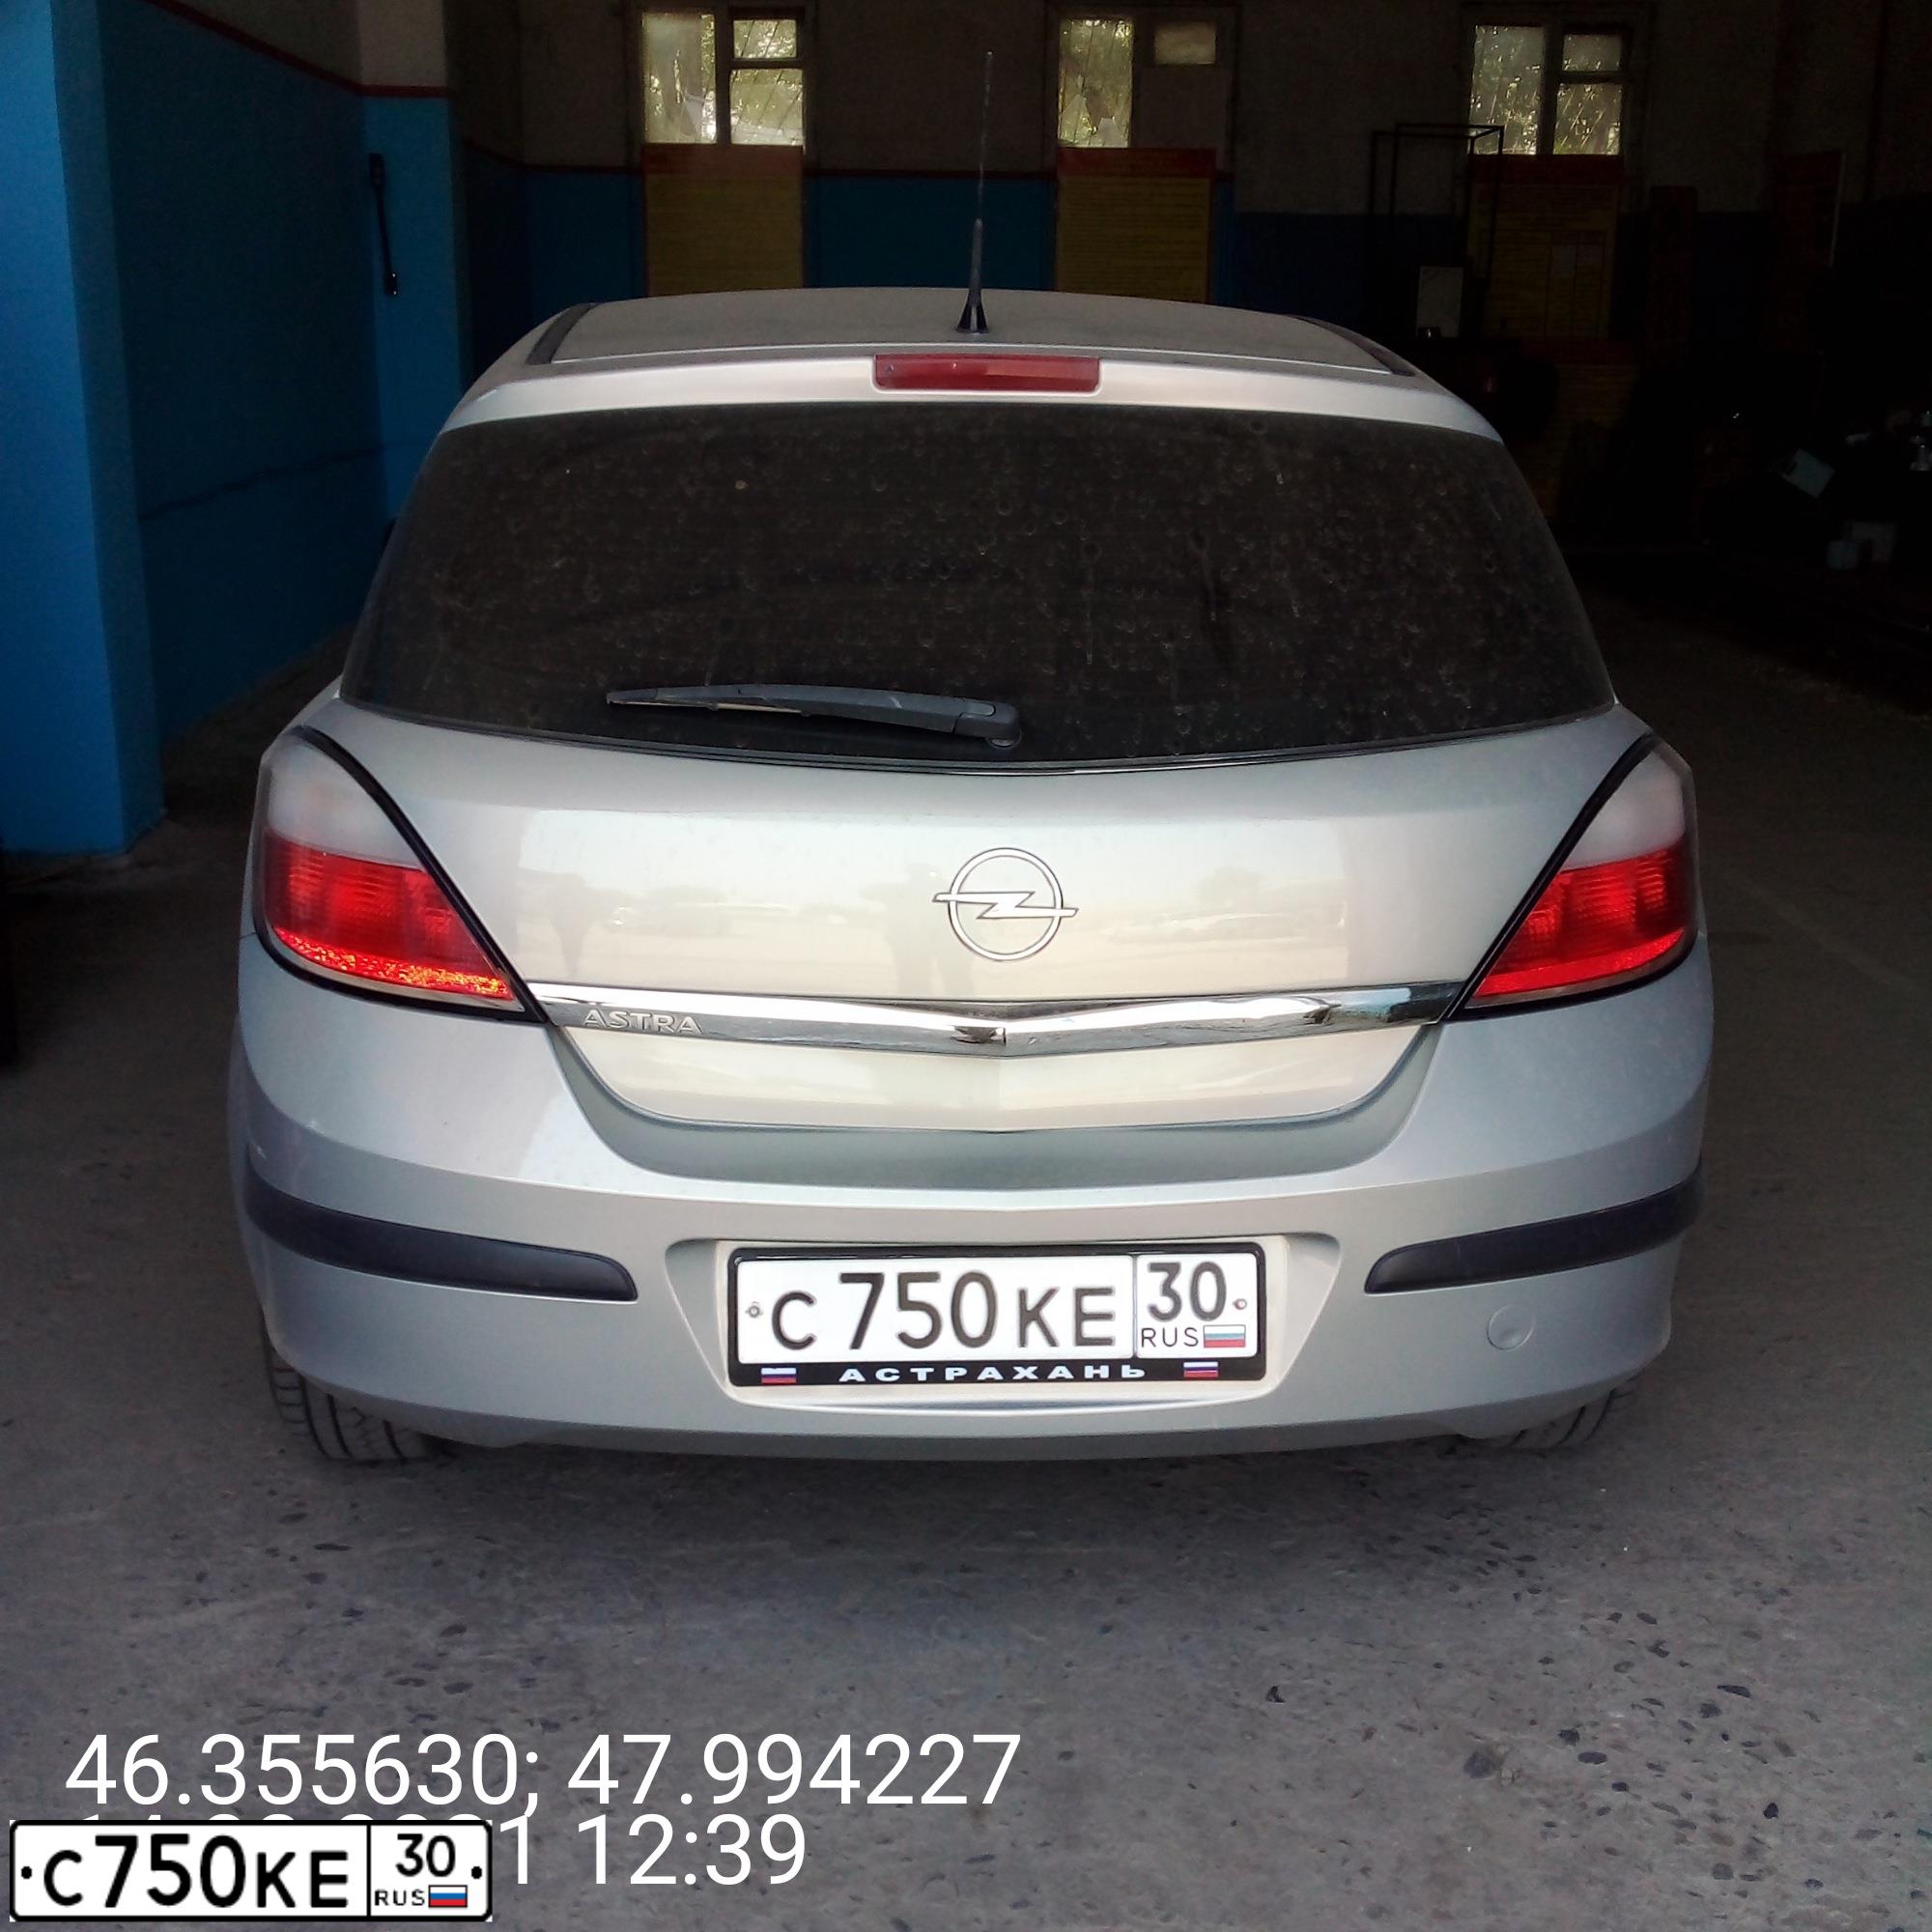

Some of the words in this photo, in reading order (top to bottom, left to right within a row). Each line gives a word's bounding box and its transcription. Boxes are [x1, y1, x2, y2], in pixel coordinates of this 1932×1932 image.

[582, 1009, 703, 1036] ASTRA
[1149, 1262, 1227, 1321] 30
[1141, 1326, 1199, 1348] RUS
[838, 1365, 1147, 1382] АСТРАХАНЬ
